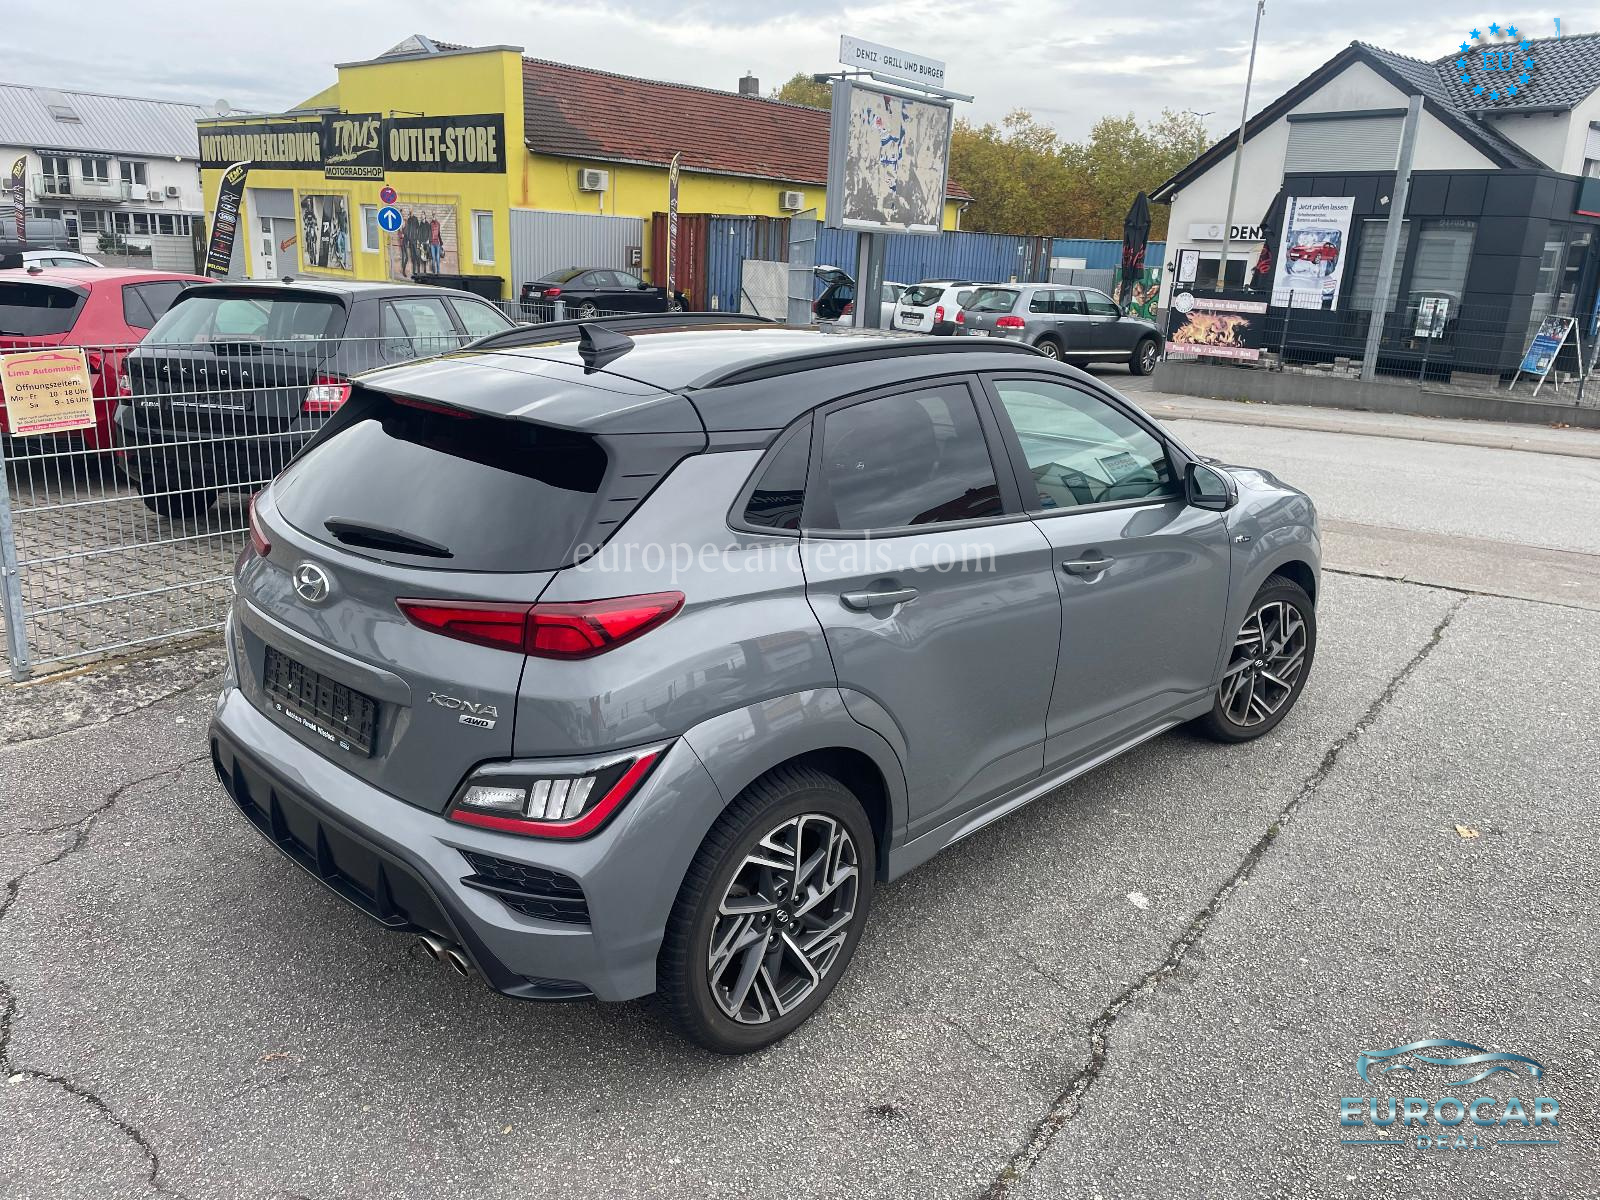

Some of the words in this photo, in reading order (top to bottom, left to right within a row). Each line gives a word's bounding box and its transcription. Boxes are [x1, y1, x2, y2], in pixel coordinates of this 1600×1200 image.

[856, 47, 878, 62] DENIZ
[883, 55, 903, 69] GRILL
[904, 62, 918, 72] UND
[919, 64, 944, 79] BURGER
[201, 132, 321, 162] MOTORRADBEKLEIDUNG
[390, 126, 498, 163] OUTLET-STORE
[326, 166, 383, 178] MOTORRADSHOP
[32, 364, 81, 375] Automobile
[15, 380, 81, 392] Öffnungszeiten:
[427, 691, 500, 718] KONA
